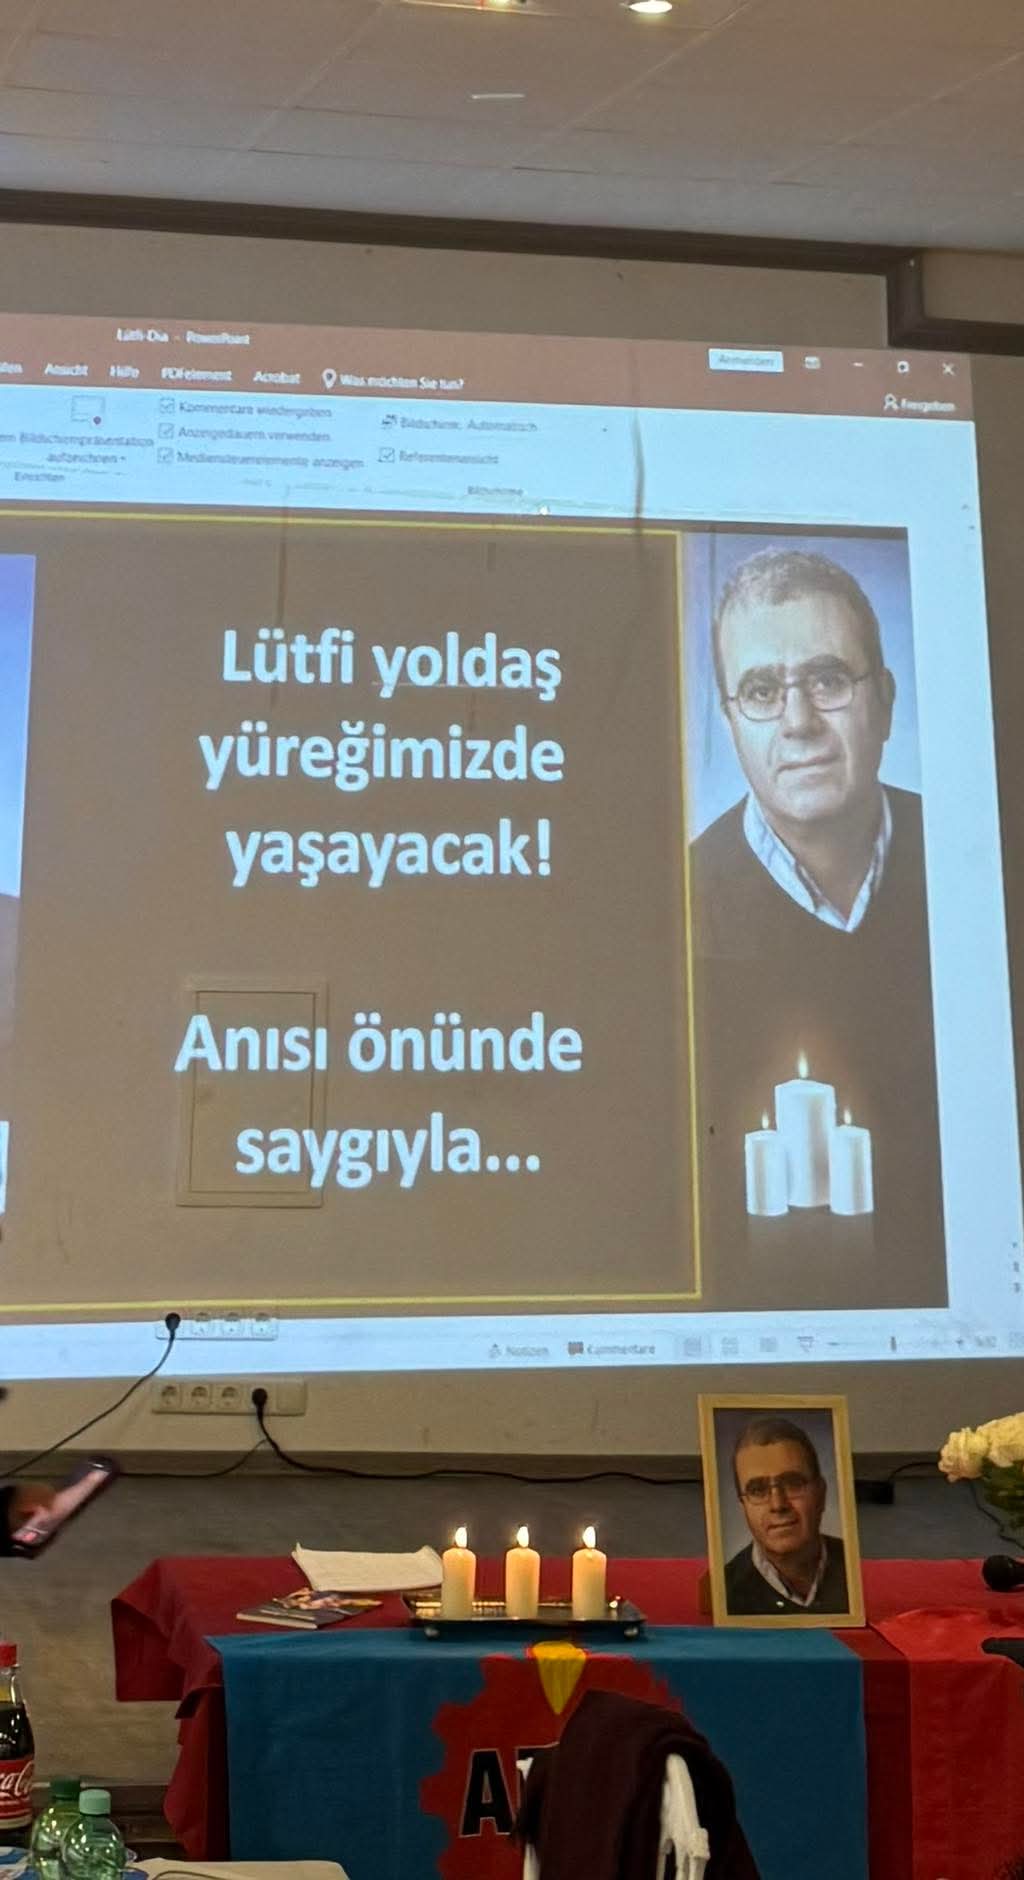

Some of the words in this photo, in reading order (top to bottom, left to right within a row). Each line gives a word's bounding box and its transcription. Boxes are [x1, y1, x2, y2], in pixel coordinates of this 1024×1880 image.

[222, 627, 355, 684] Lütfi
[371, 631, 562, 702] yoldaş
[198, 720, 565, 792] yüreğimizde
[225, 817, 552, 888] yaşayacak!
[174, 1013, 328, 1072] Anısı
[348, 1011, 583, 1072] önünde
[235, 1111, 541, 1188] saygıyla...
